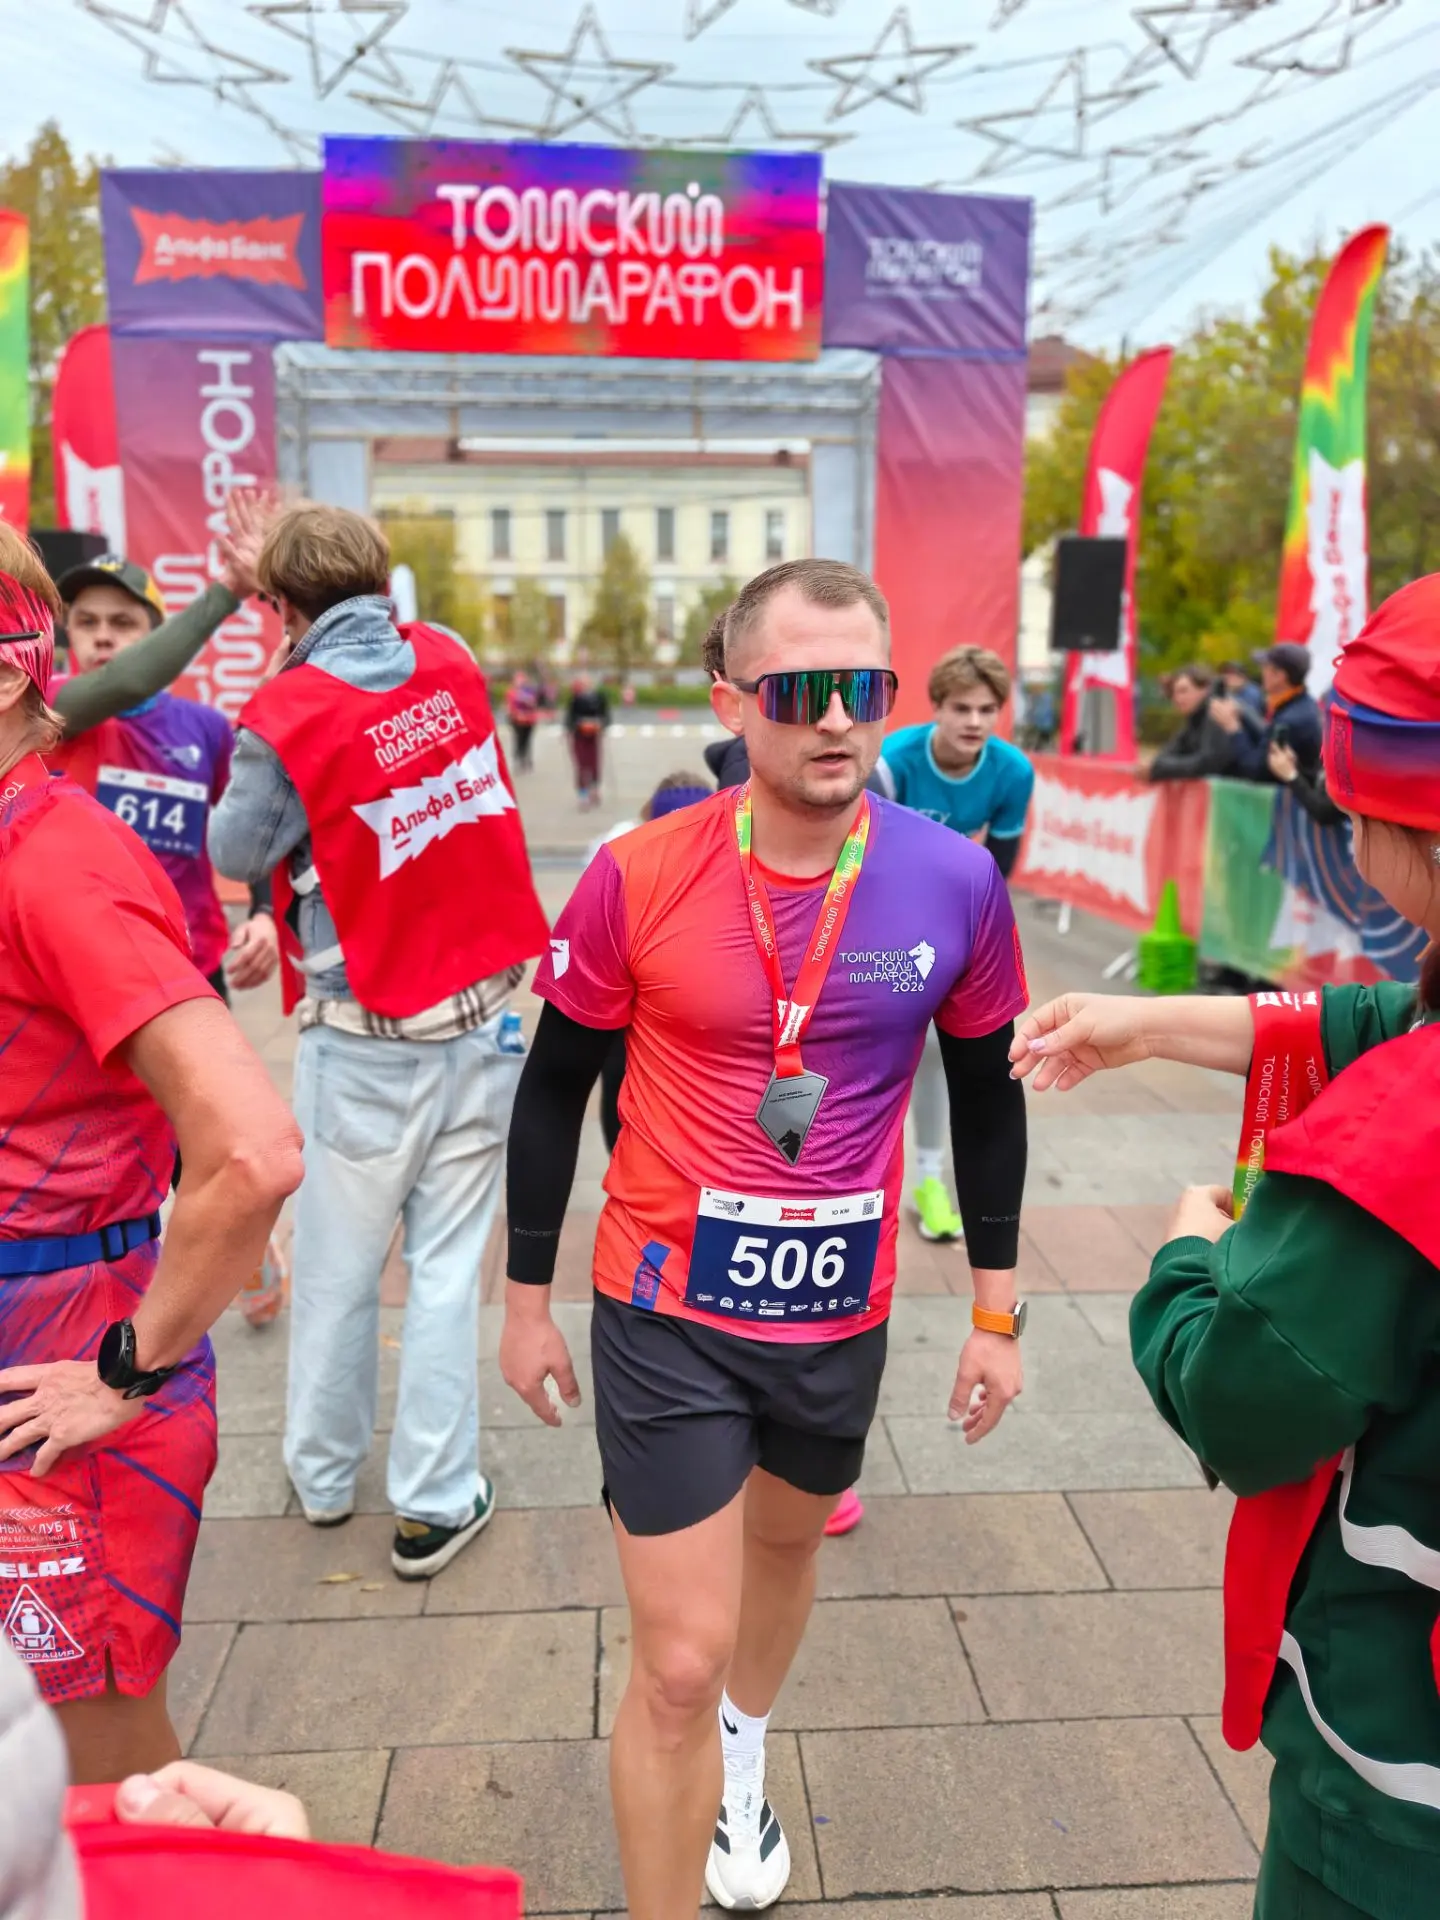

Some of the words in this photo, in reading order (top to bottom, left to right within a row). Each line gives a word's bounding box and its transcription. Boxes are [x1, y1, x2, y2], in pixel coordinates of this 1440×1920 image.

[437, 182, 723, 257] ТОМСКИЙ
[352, 252, 802, 330] ПОЛУМАРАФОН
[363, 689, 456, 746] ТОМСКИЙ
[374, 709, 466, 768] МАРАФОН
[115, 793, 185, 835] 614
[390, 793, 455, 840] Альфа
[749, 900, 775, 959] ТОМСКИЙ
[811, 906, 839, 963] ТОМСКИЙ
[839, 949, 907, 963] ТОМСКИЙ
[850, 971, 918, 983] МАРАФОН
[875, 962, 913, 971] ПОЛУ
[892, 982, 925, 992] 2026
[1254, 1055, 1276, 1123] ТОМСКИЙ
[1239, 1128, 1265, 1208] ПОЛУМА
[727, 1235, 847, 1290] 506
